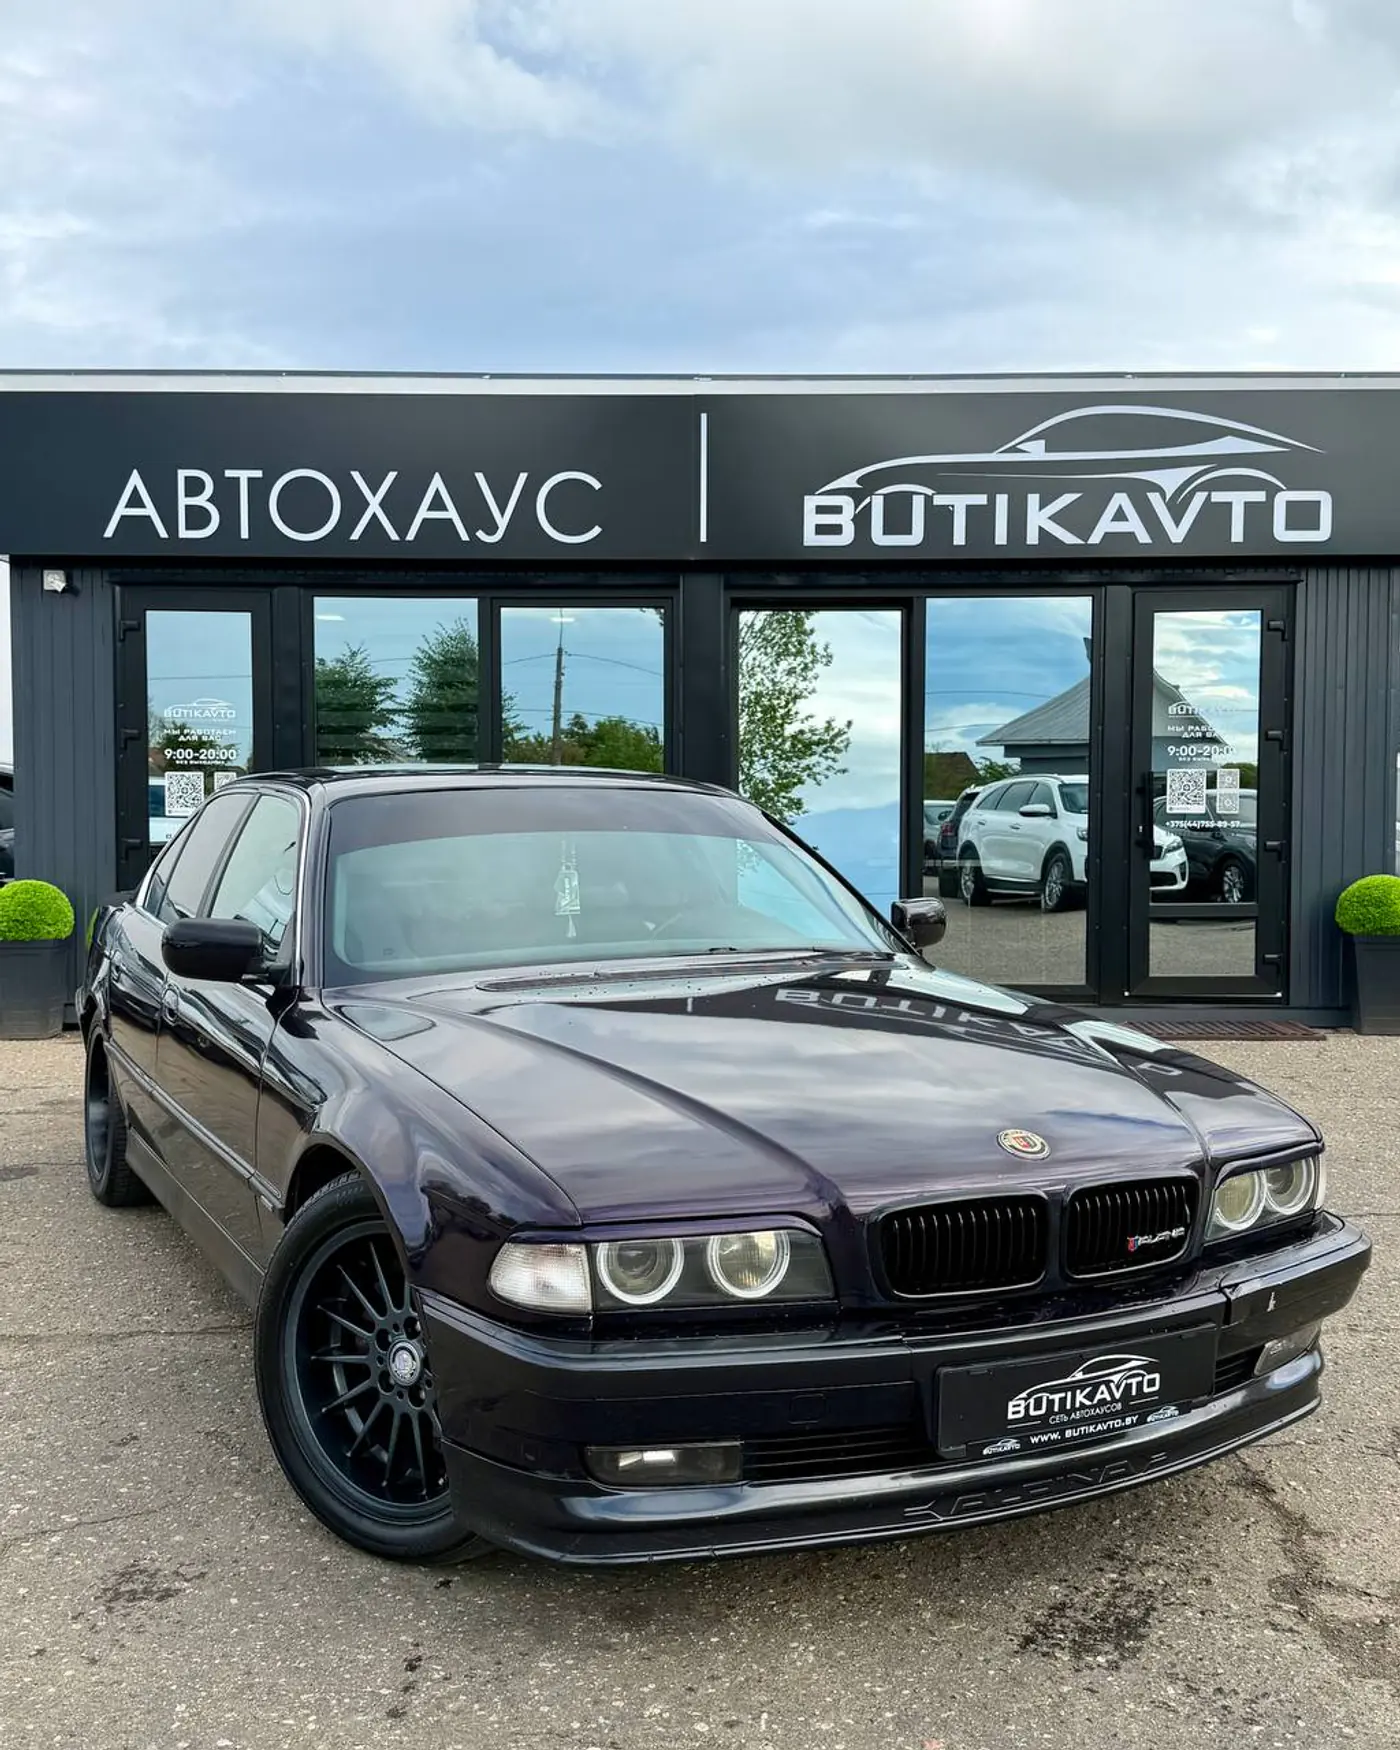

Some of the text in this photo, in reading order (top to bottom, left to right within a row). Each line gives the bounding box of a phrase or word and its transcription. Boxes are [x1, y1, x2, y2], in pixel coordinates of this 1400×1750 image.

[103, 468, 603, 544] АВТОХАУС
[803, 489, 1333, 547] BUTIKAVTO
[164, 708, 236, 718] BUTIKAVTO
[164, 748, 237, 760] 9:00-20:00
[1007, 1373, 1160, 1420] BUTIKAVTO
[1048, 1402, 1122, 1425] СЕТЬ АВТОХАУСОВ
[1029, 1415, 1139, 1444] WWW. BUTIKAVTO.BY
